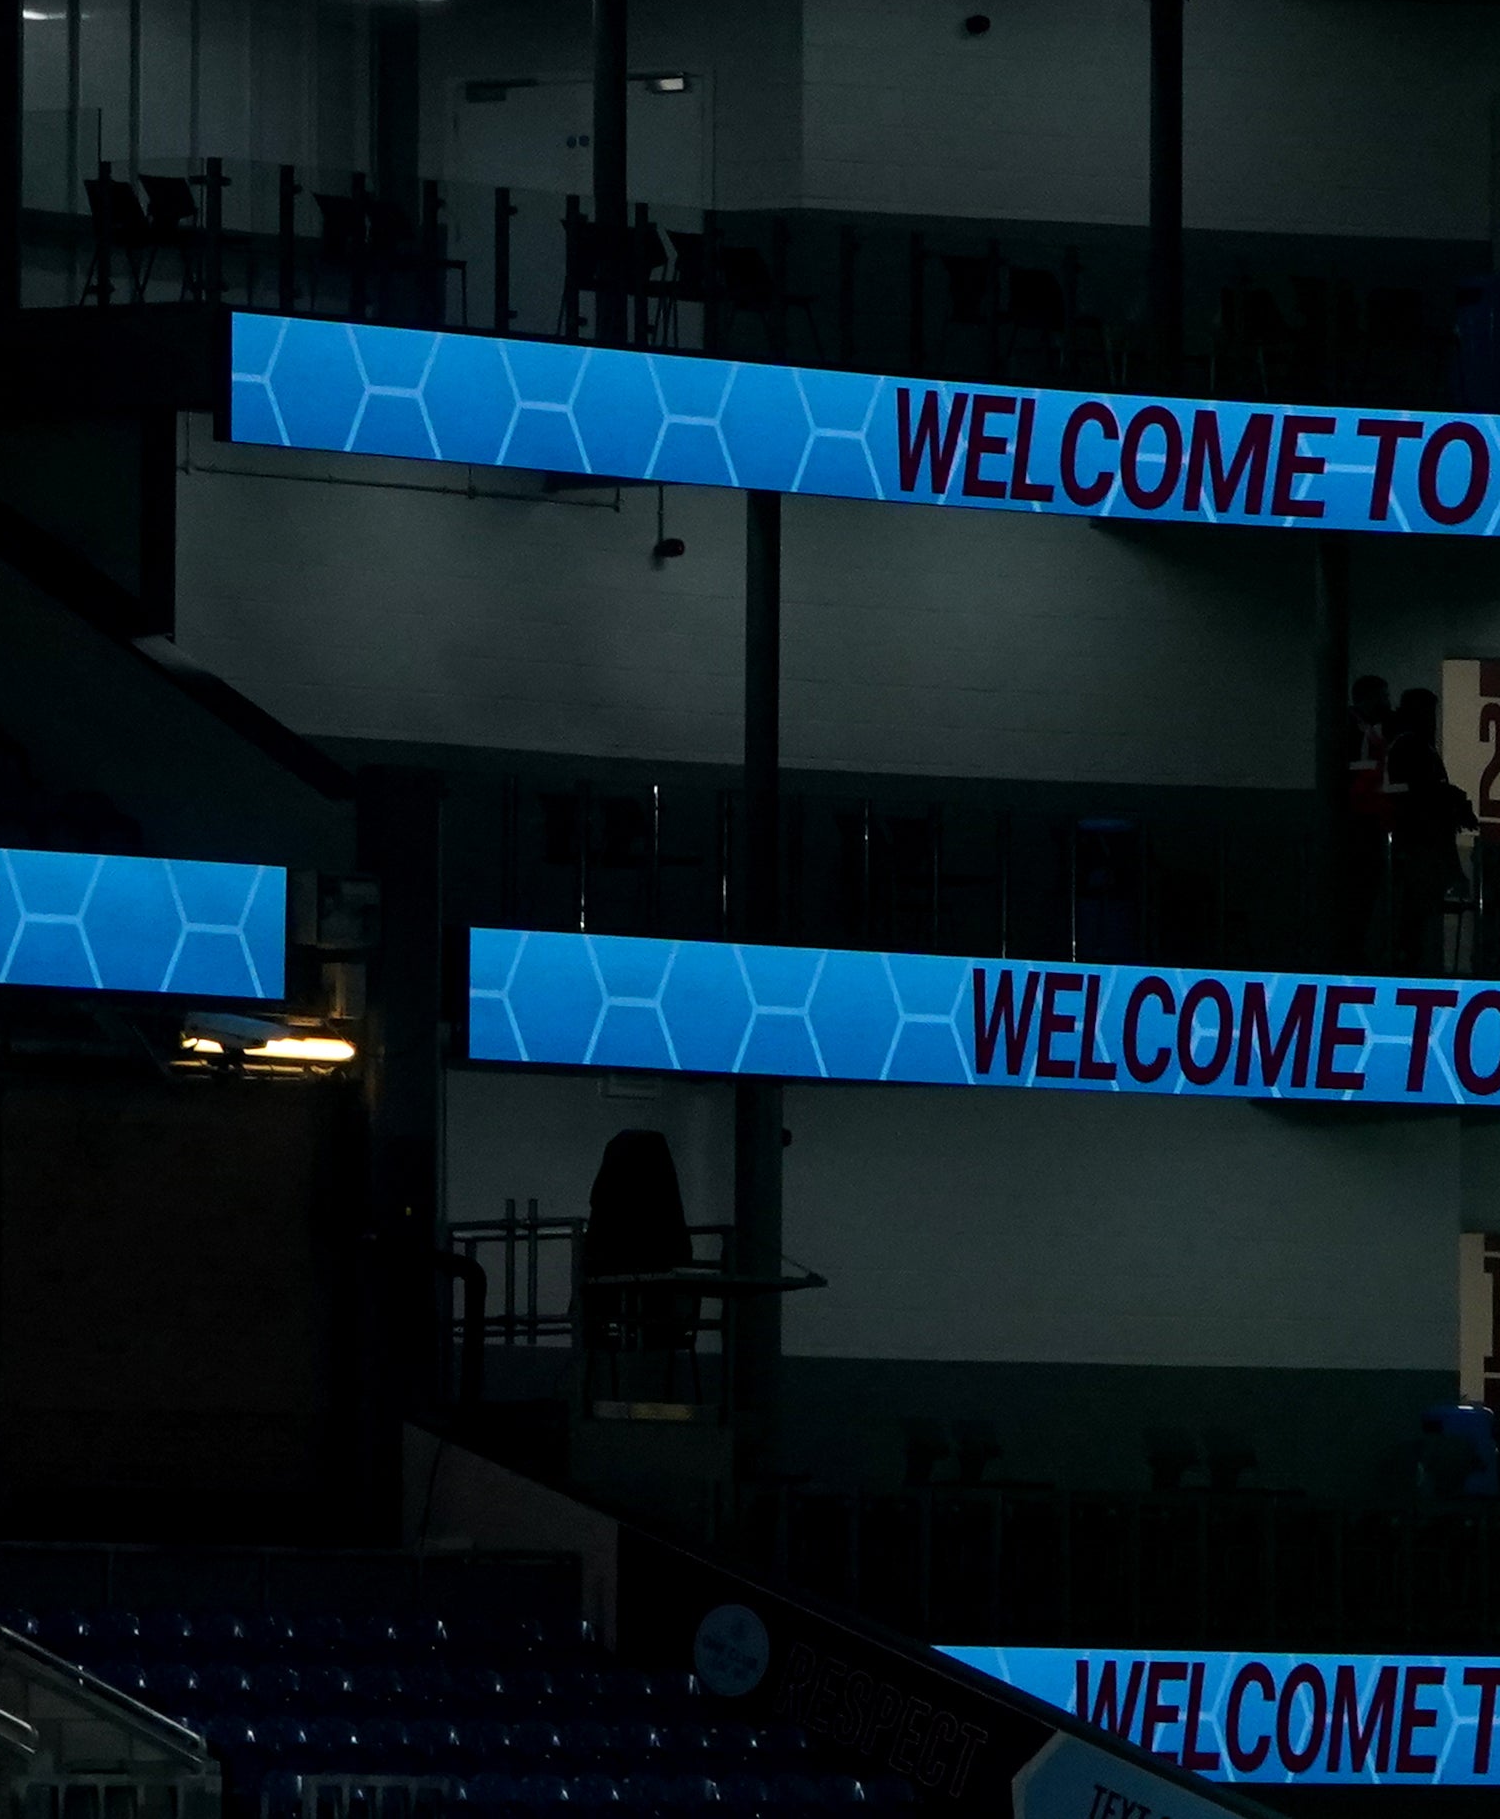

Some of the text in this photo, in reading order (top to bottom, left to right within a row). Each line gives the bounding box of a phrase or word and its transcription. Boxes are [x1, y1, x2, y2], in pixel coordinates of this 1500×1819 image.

[896, 387, 1337, 519] WELCOME
[1356, 418, 1490, 527] TO
[972, 968, 1376, 1091] WELCOME
[772, 1641, 990, 1799] RESPECT
[1075, 1660, 1446, 1775] WELCOME
